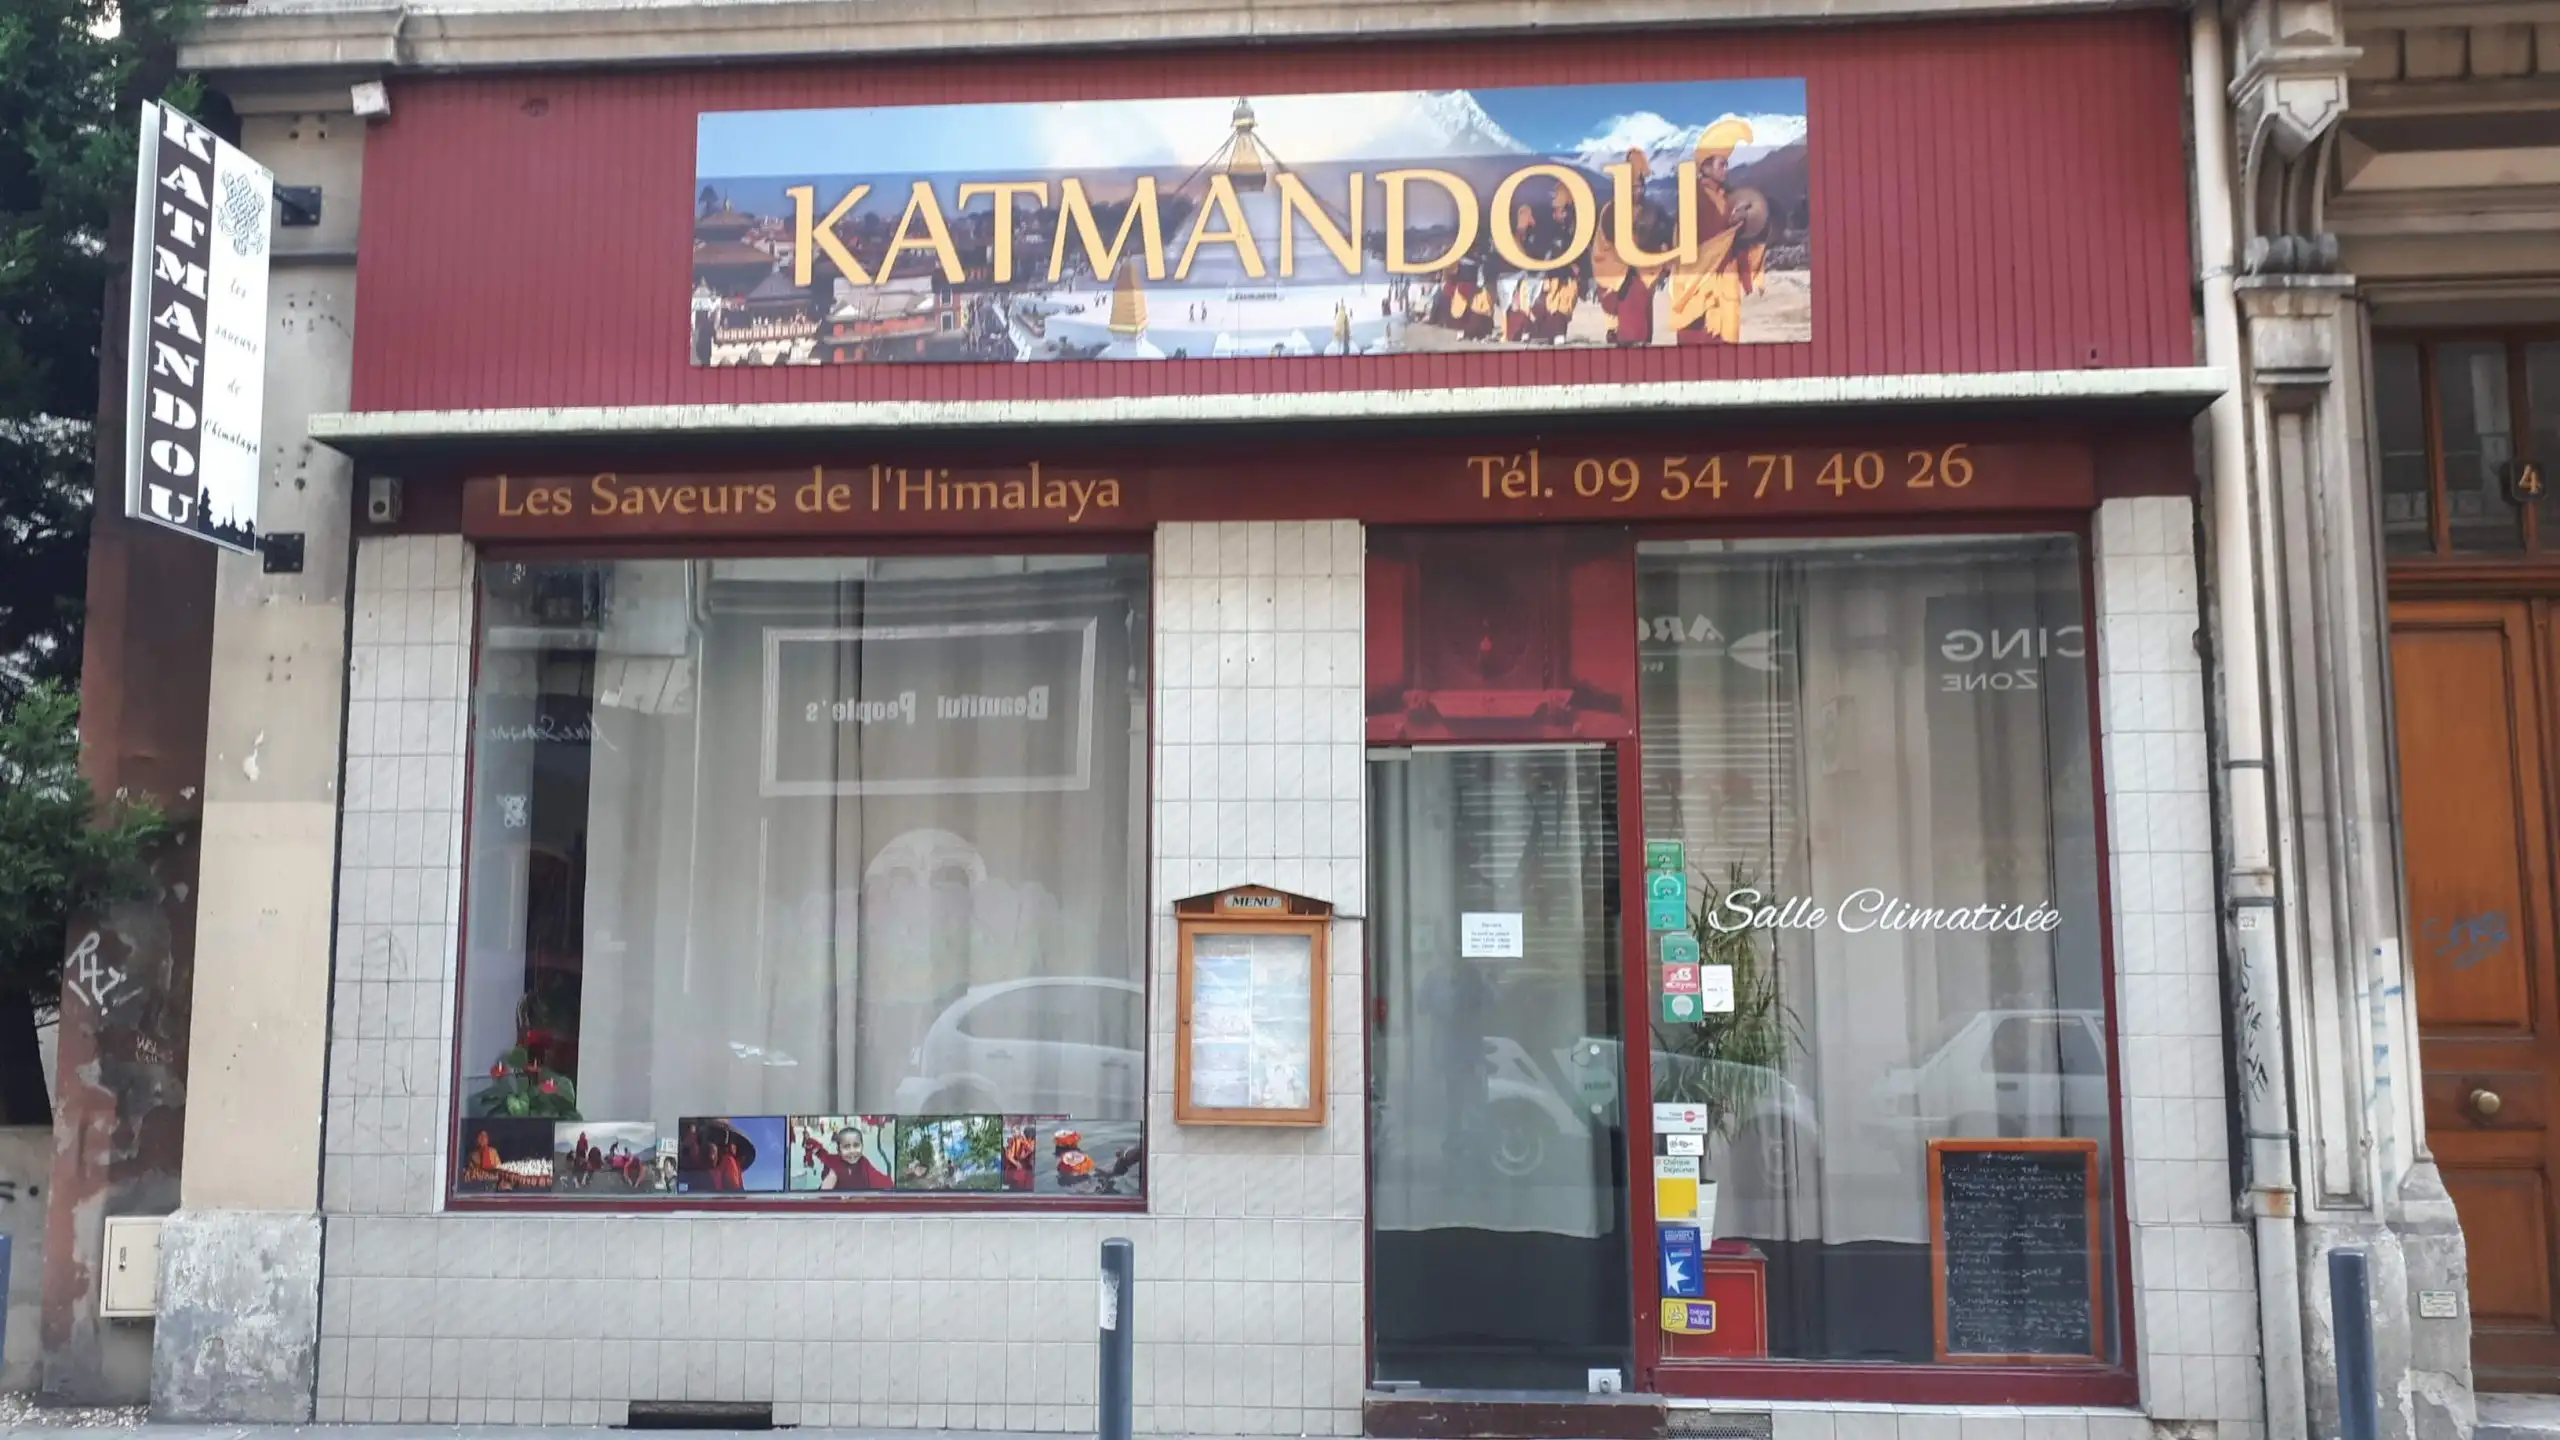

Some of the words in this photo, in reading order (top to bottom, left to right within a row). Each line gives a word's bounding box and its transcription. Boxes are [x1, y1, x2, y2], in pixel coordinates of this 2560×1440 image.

[786, 158, 1698, 287] KATMANDOU
[149, 108, 212, 524] KATMANDOU
[227, 377, 241, 398] de
[496, 474, 573, 516] Les
[591, 472, 777, 516] Saveurs
[795, 464, 851, 513] de
[869, 460, 1120, 523] l'Himalaya
[1467, 449, 1553, 498] Tél.
[1574, 456, 1640, 502] 09
[1661, 455, 1728, 501] 54
[1747, 454, 1794, 499] 71
[1816, 452, 1885, 497] 40
[1907, 443, 1974, 488] 26
[2517, 464, 2542, 494] 4
[1232, 896, 1275, 908] MENU
[1707, 888, 1827, 932] Salle
[1837, 888, 2063, 933] Climatisée
